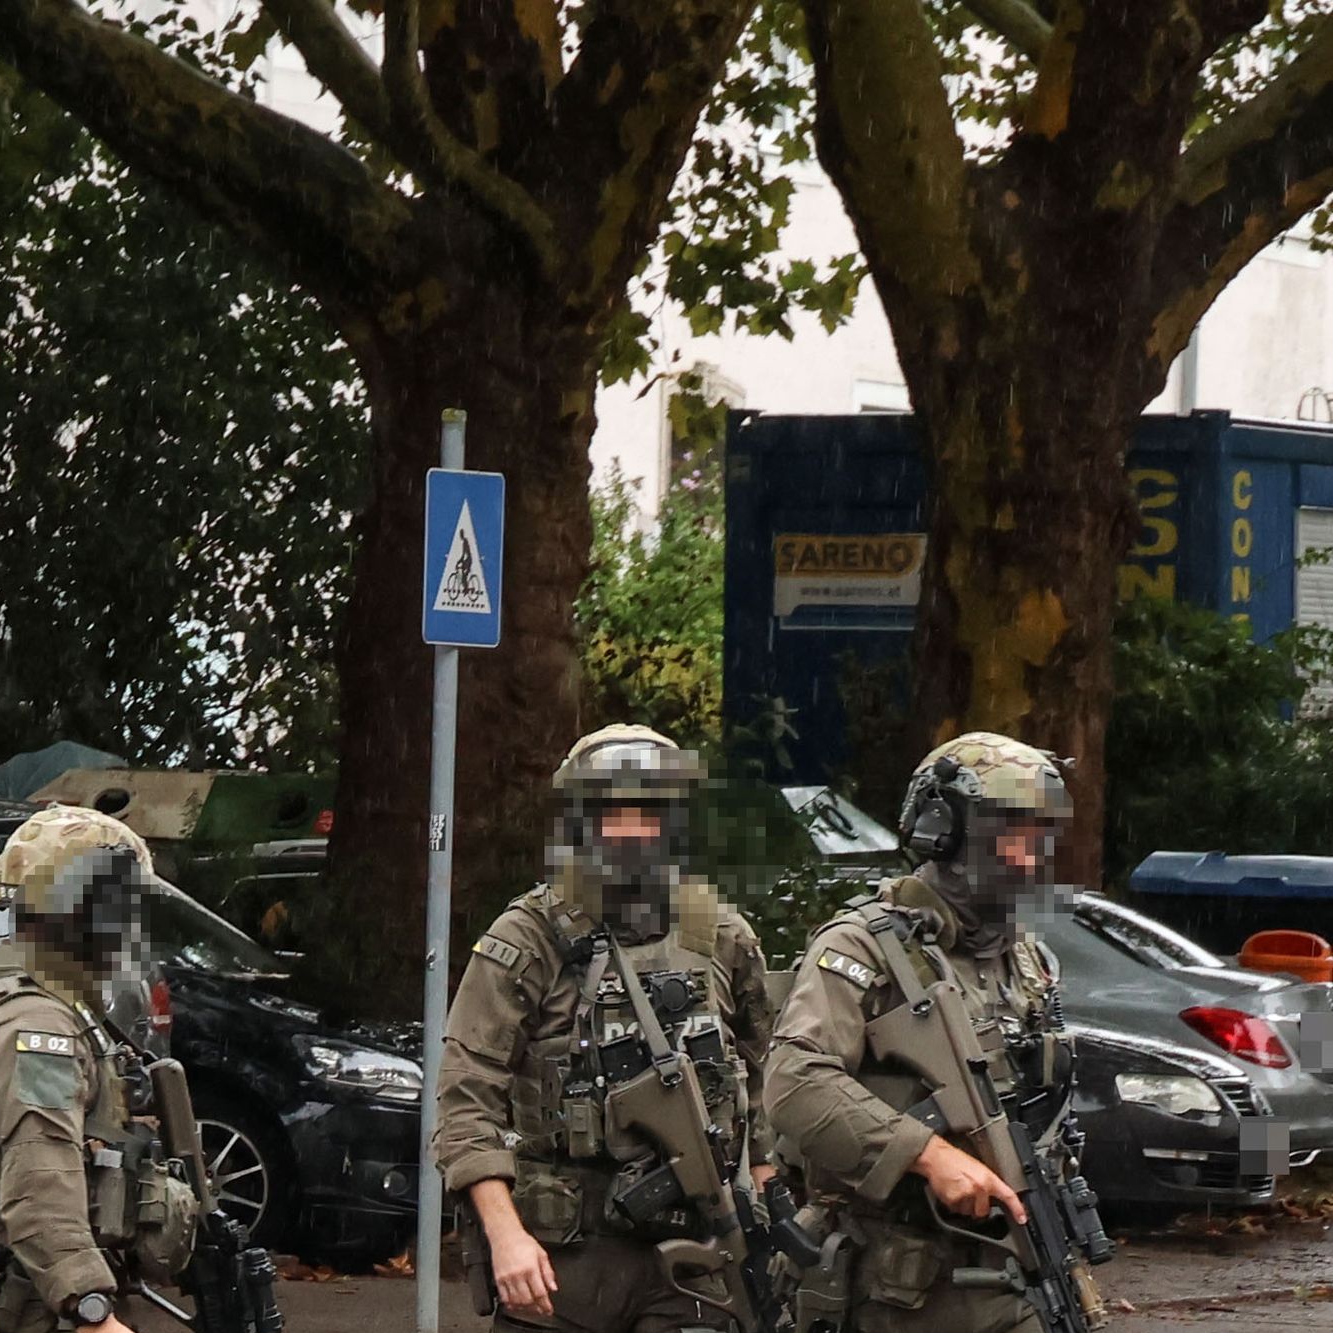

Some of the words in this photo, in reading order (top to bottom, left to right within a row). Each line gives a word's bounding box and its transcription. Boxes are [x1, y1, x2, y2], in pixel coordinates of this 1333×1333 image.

[779, 541, 914, 573] SARENO
[1231, 470, 1253, 622] CON
[831, 956, 844, 970] A
[848, 963, 869, 982] 04
[29, 1034, 42, 1048] B
[47, 1037, 69, 1052] 02
